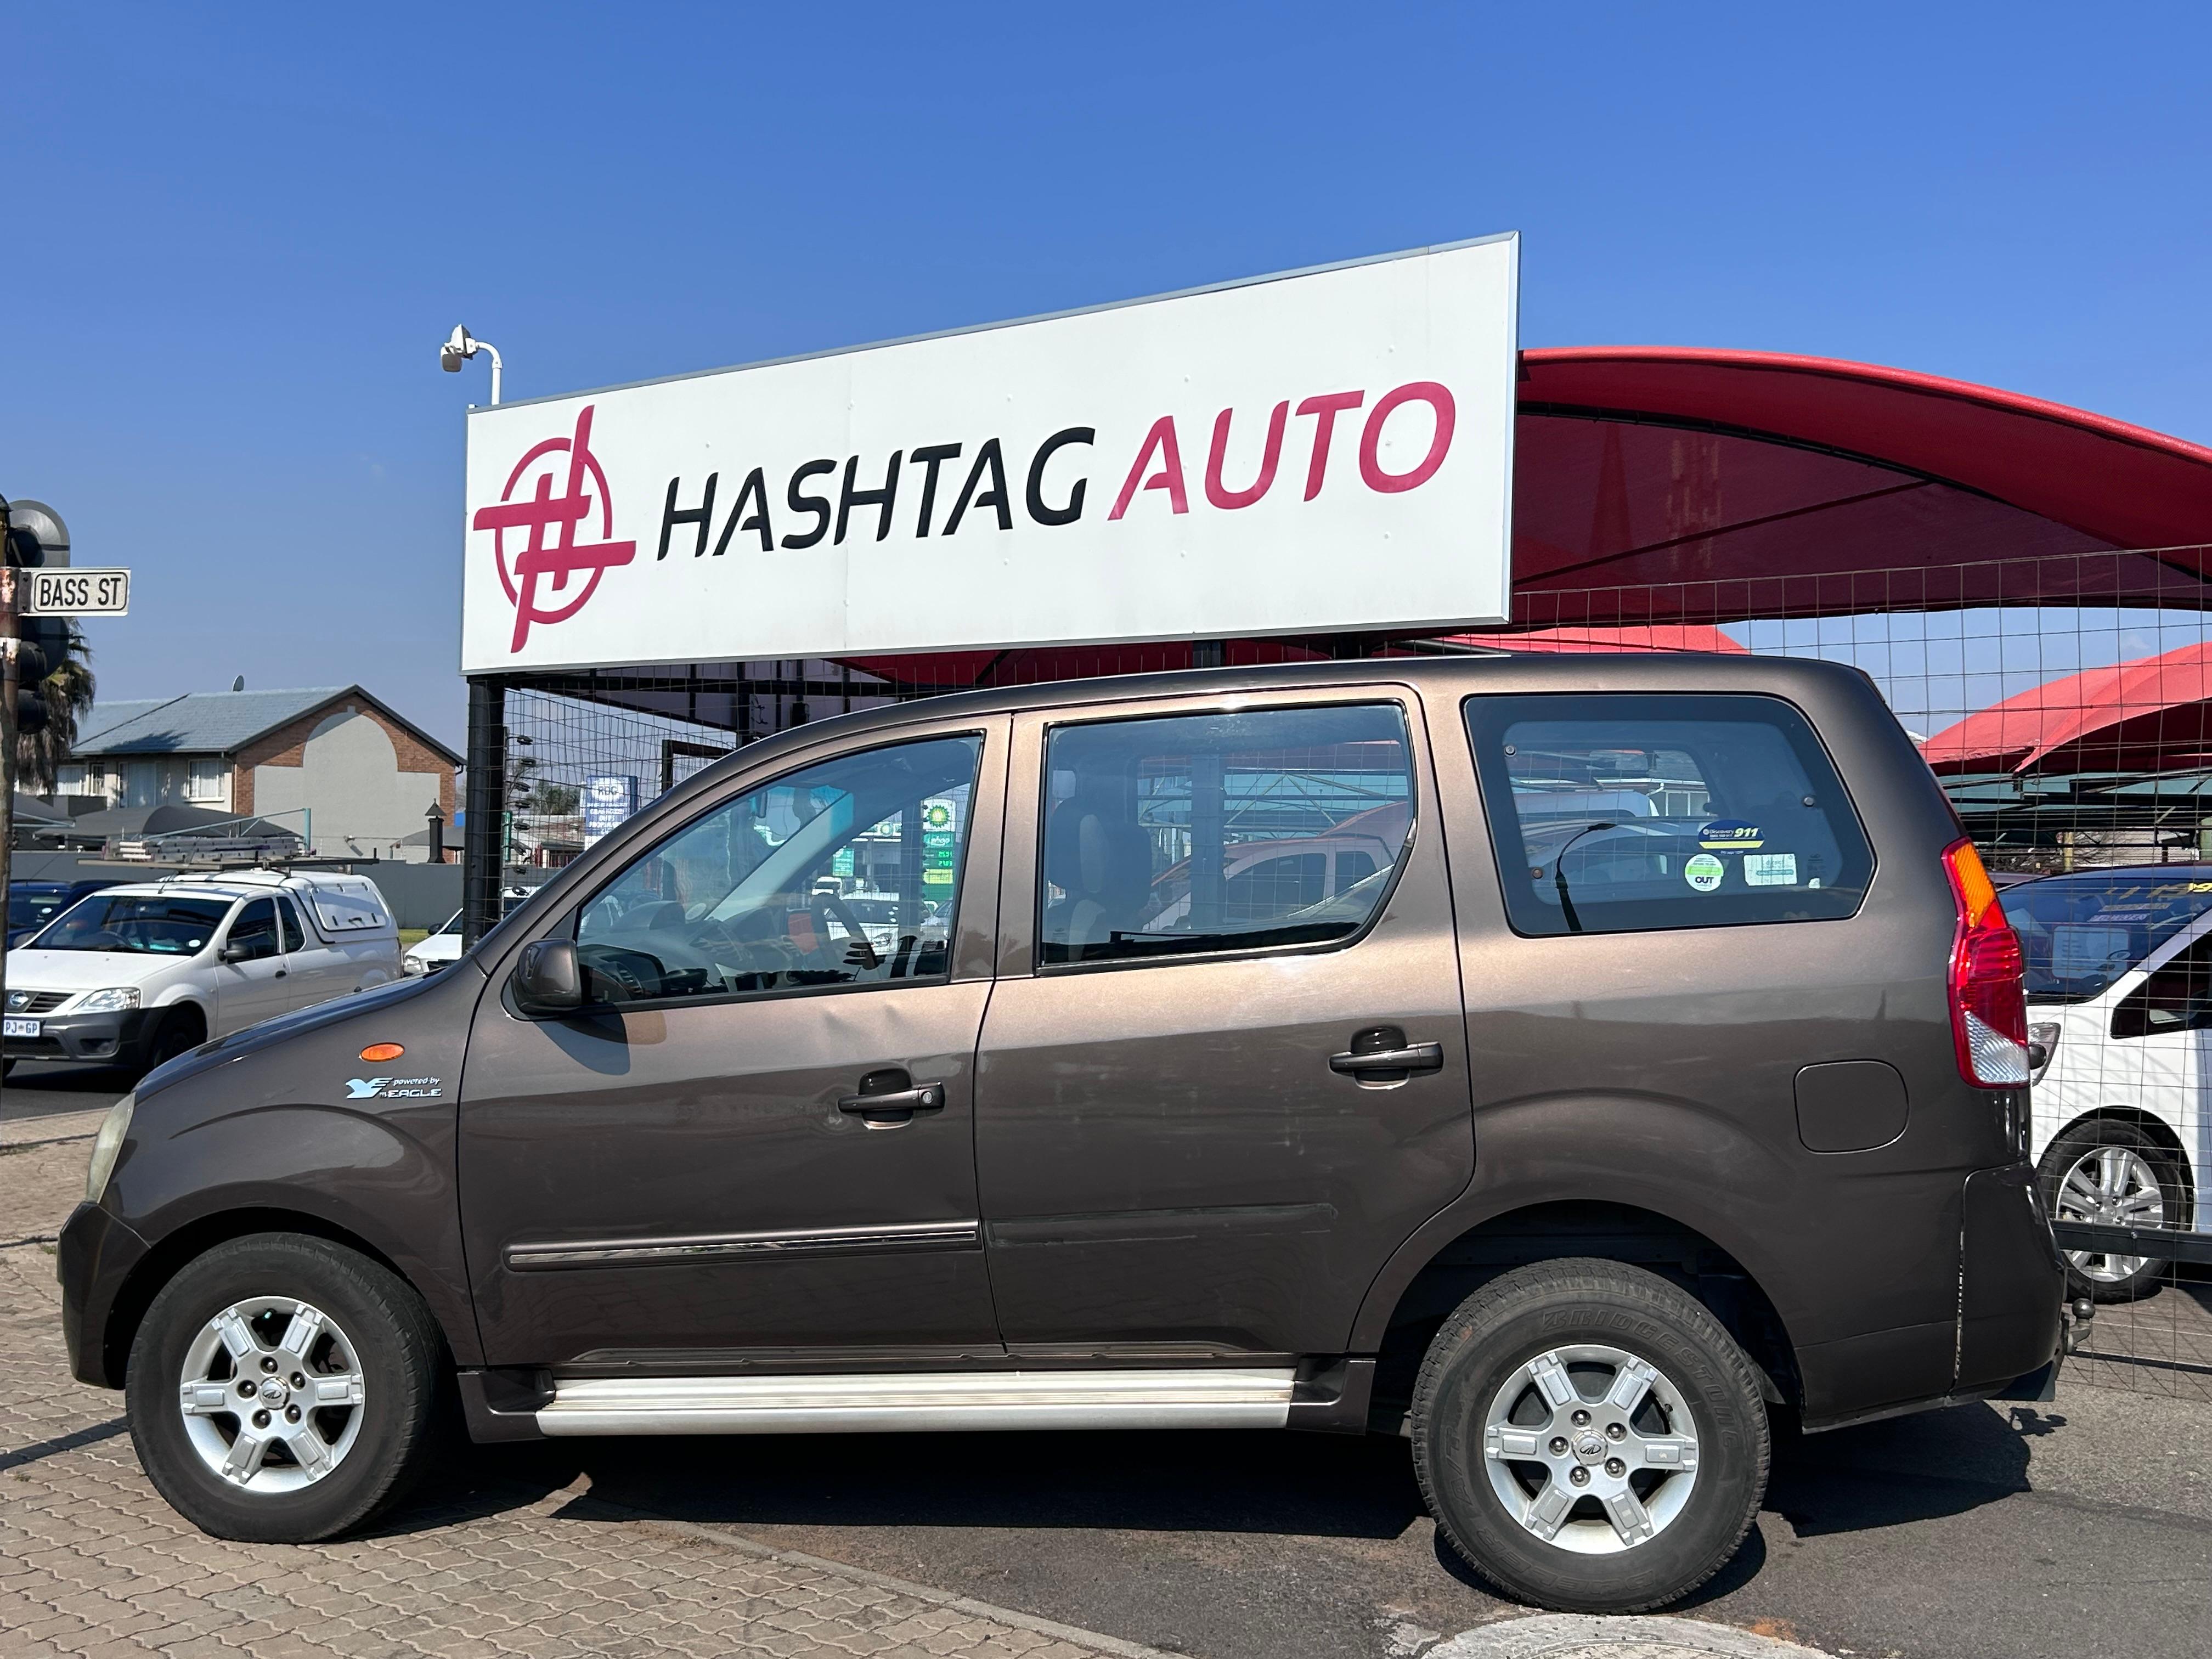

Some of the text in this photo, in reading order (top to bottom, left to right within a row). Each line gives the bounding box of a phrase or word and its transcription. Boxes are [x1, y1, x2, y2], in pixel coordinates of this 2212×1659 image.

[657, 381, 1455, 561] HASHTAG AUTO
[40, 578, 121, 606] BASS ST
[1734, 827, 1759, 838] 911
[393, 1076, 441, 1086] powered by
[1541, 1308, 1740, 1449] BRIDGESTONE
